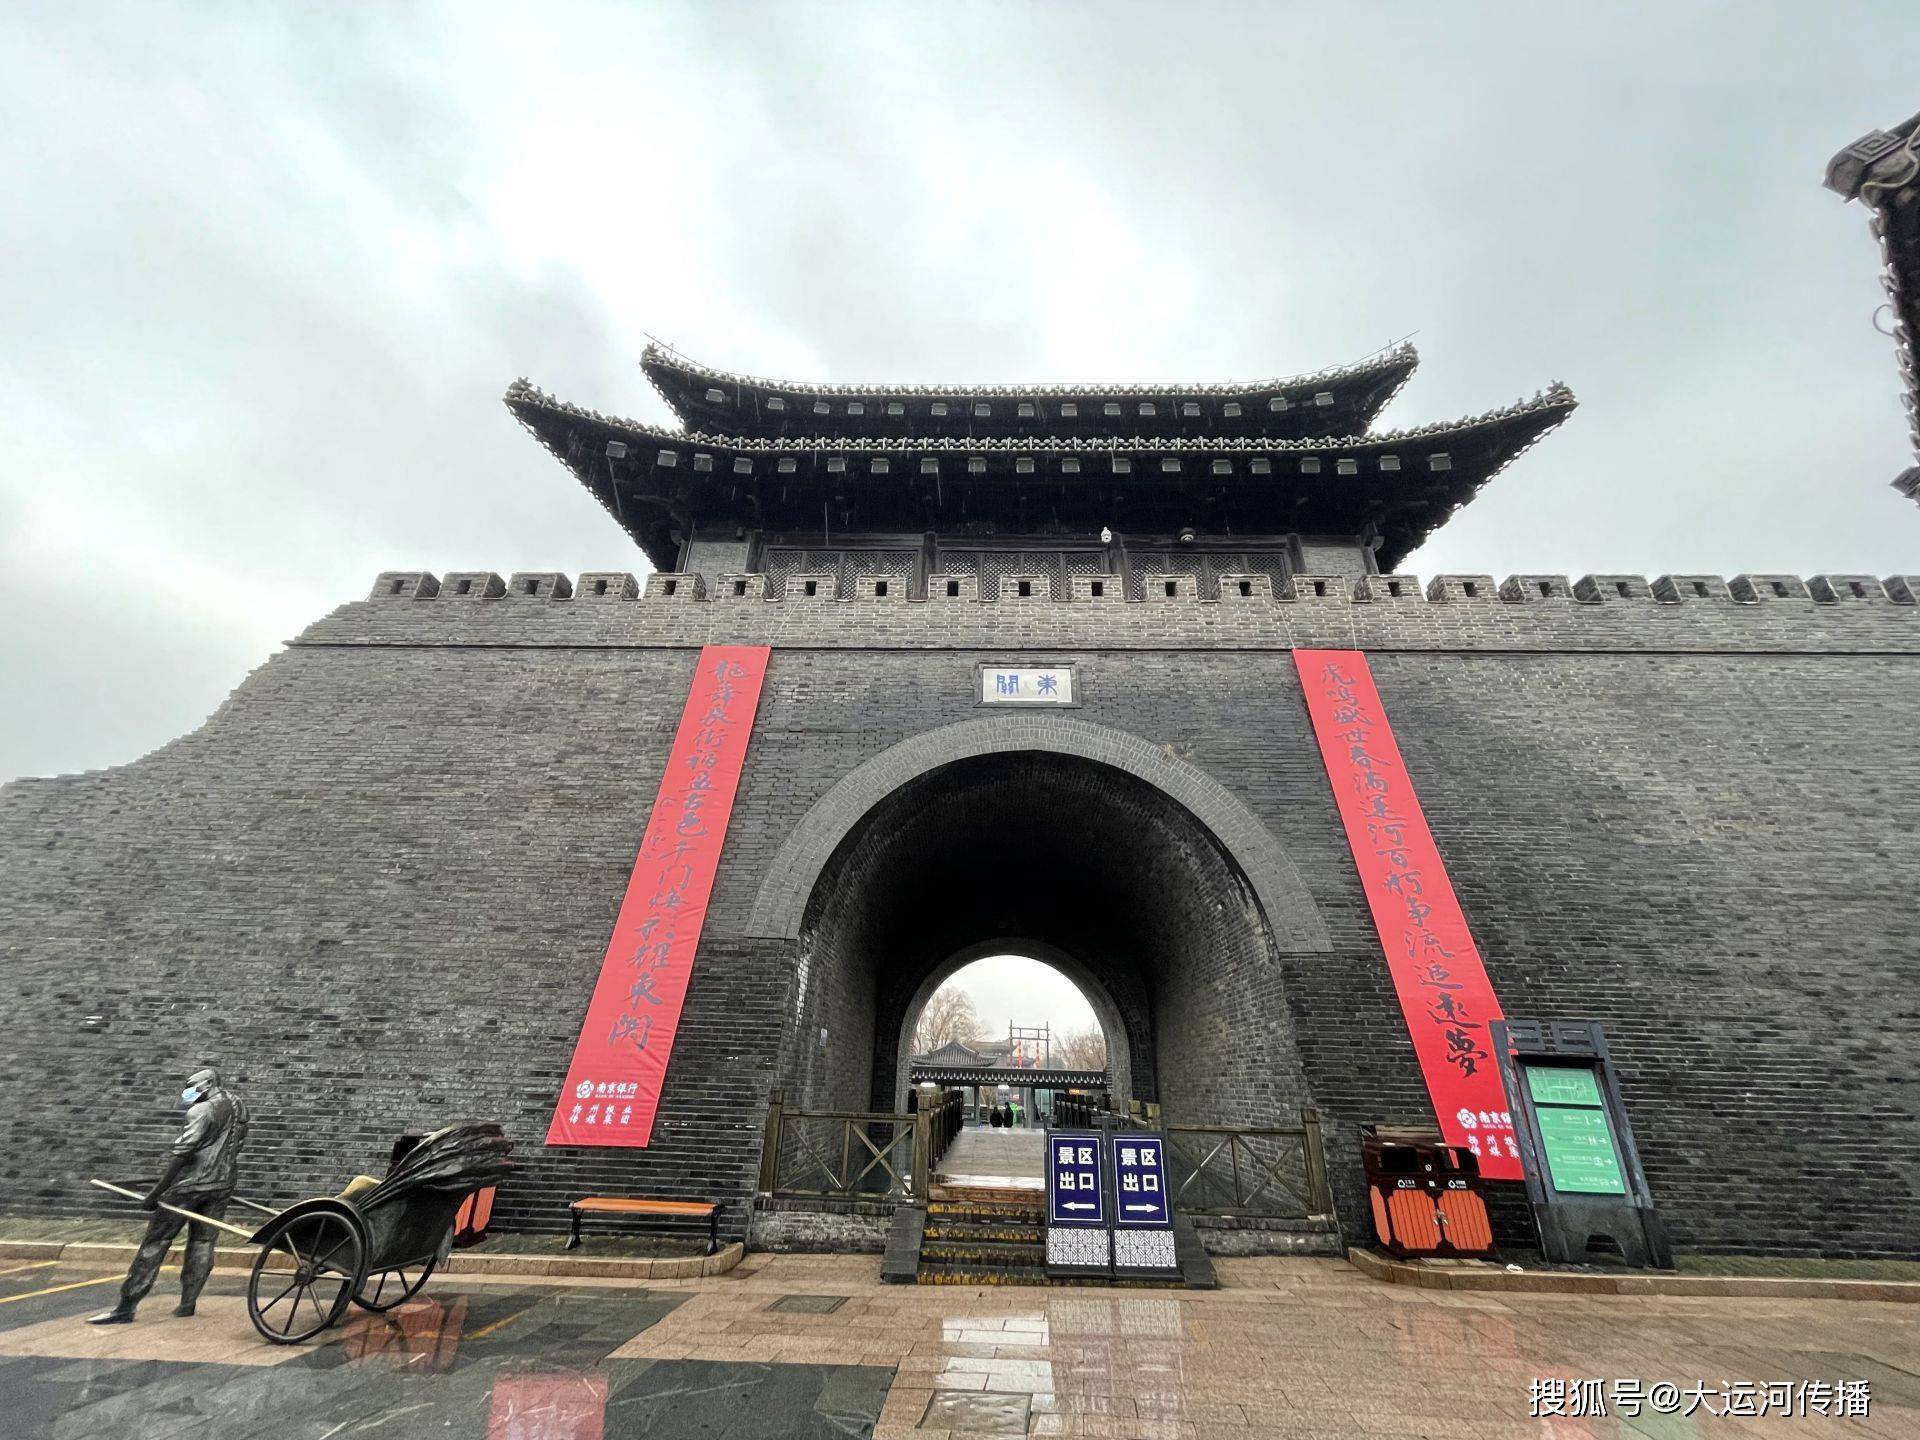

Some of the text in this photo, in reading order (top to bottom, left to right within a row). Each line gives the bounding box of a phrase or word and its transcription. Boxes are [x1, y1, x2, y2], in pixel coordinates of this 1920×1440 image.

[597, 1082, 638, 1095] 南京银行
[1479, 1110, 1511, 1124] 南京银
[1058, 1147, 1093, 1165] 景区
[1121, 1148, 1156, 1166] 景区
[1059, 1172, 1094, 1191] 出口
[1123, 1173, 1158, 1192] 出口
